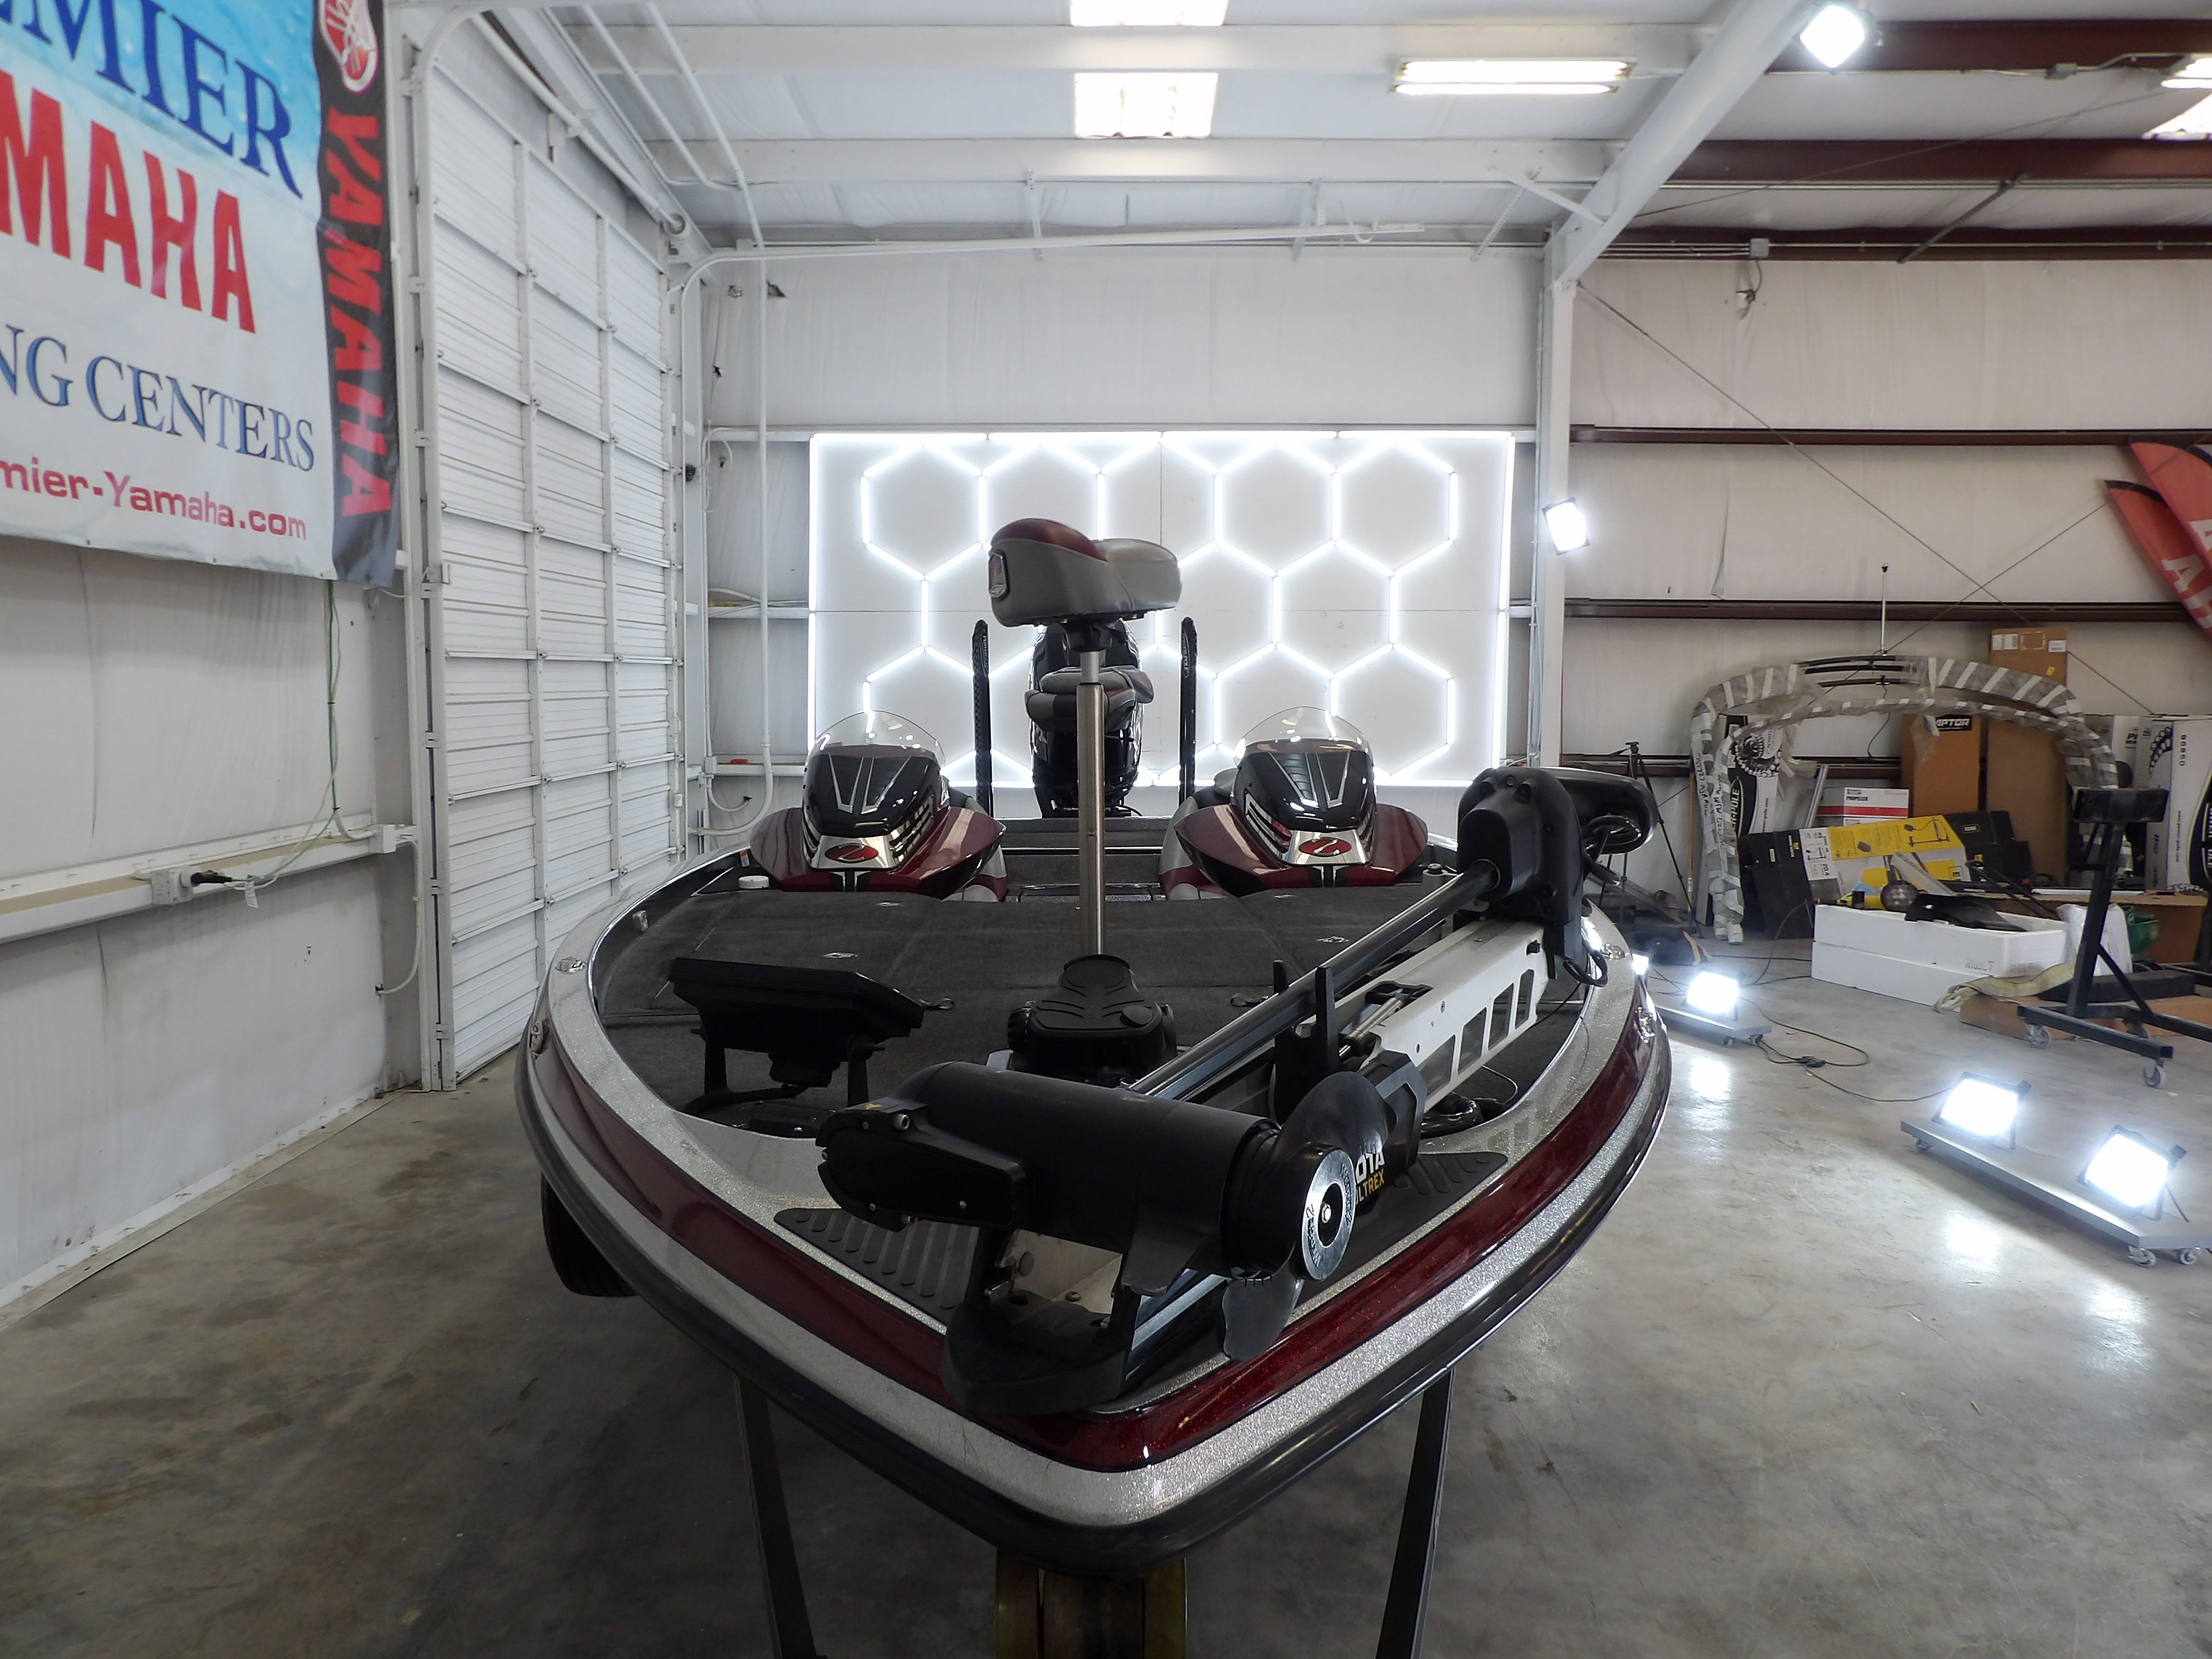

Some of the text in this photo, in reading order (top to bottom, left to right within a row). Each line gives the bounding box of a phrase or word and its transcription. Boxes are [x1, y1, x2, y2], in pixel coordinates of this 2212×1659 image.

[0, 0, 302, 200] MIER
[326, 104, 392, 517] YAMAHA
[86, 355, 314, 472] CENTERS
